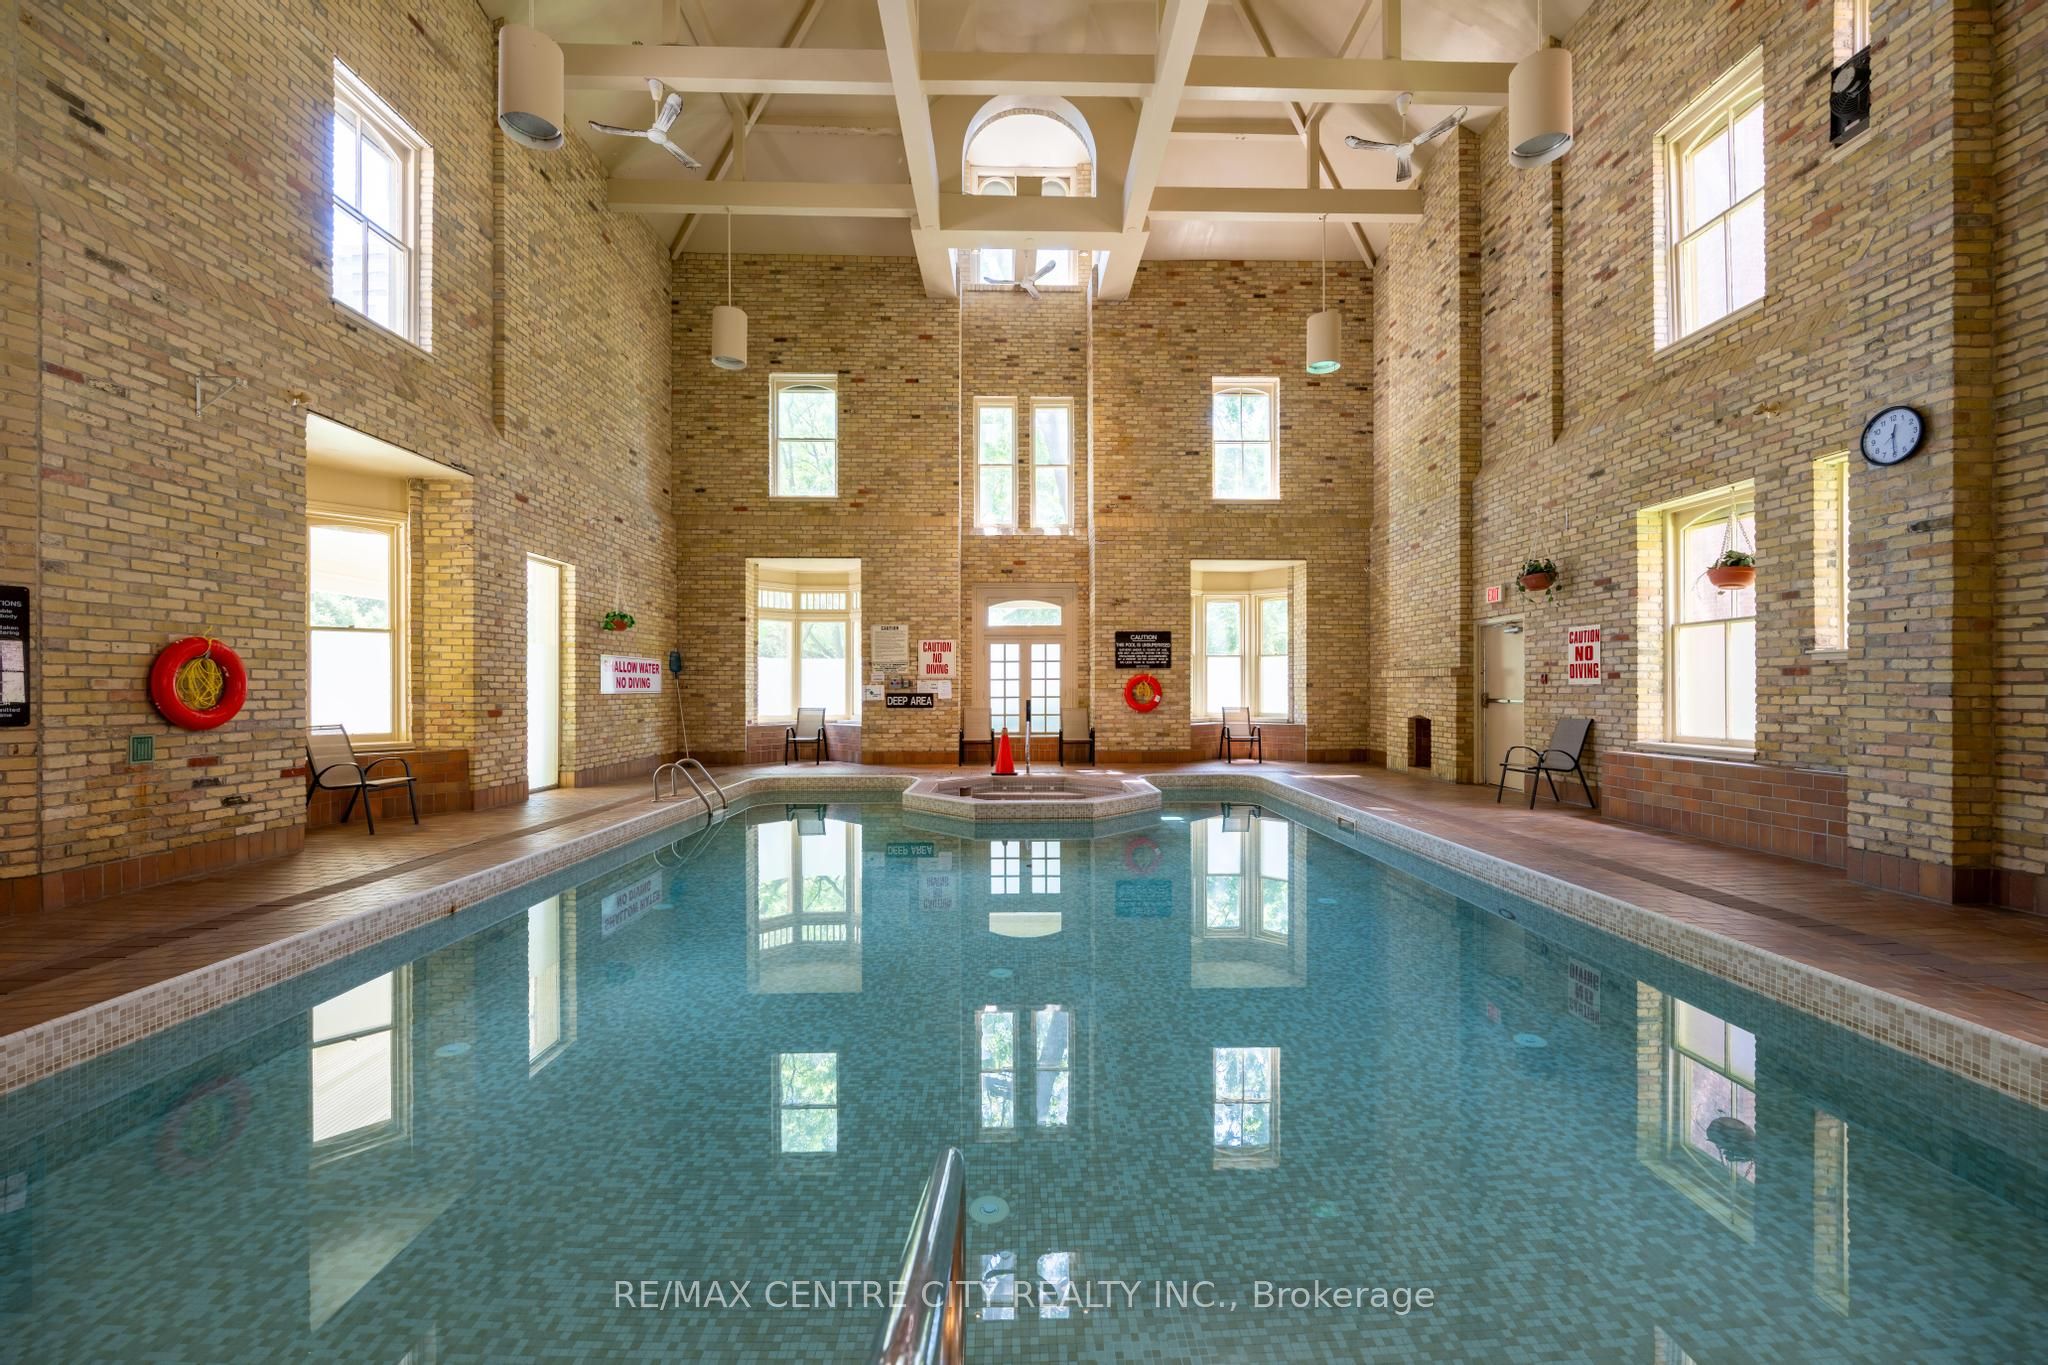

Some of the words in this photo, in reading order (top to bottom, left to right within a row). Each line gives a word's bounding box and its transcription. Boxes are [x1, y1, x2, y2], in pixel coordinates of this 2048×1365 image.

[1487, 587, 1500, 602] EXIT
[0, 600, 22, 608] IONS
[1569, 629, 1600, 644] CAUTION
[922, 641, 952, 652] CAUTION
[932, 653, 942, 663] NO
[1574, 645, 1594, 661] NO
[639, 662, 660, 674] WATER
[926, 664, 949, 674] DIVING
[1569, 663, 1600, 679] DIVING
[616, 676, 626, 688] NO
[628, 677, 651, 688] DIVING
[887, 696, 908, 705] DEEP
[910, 696, 932, 706] AREA
